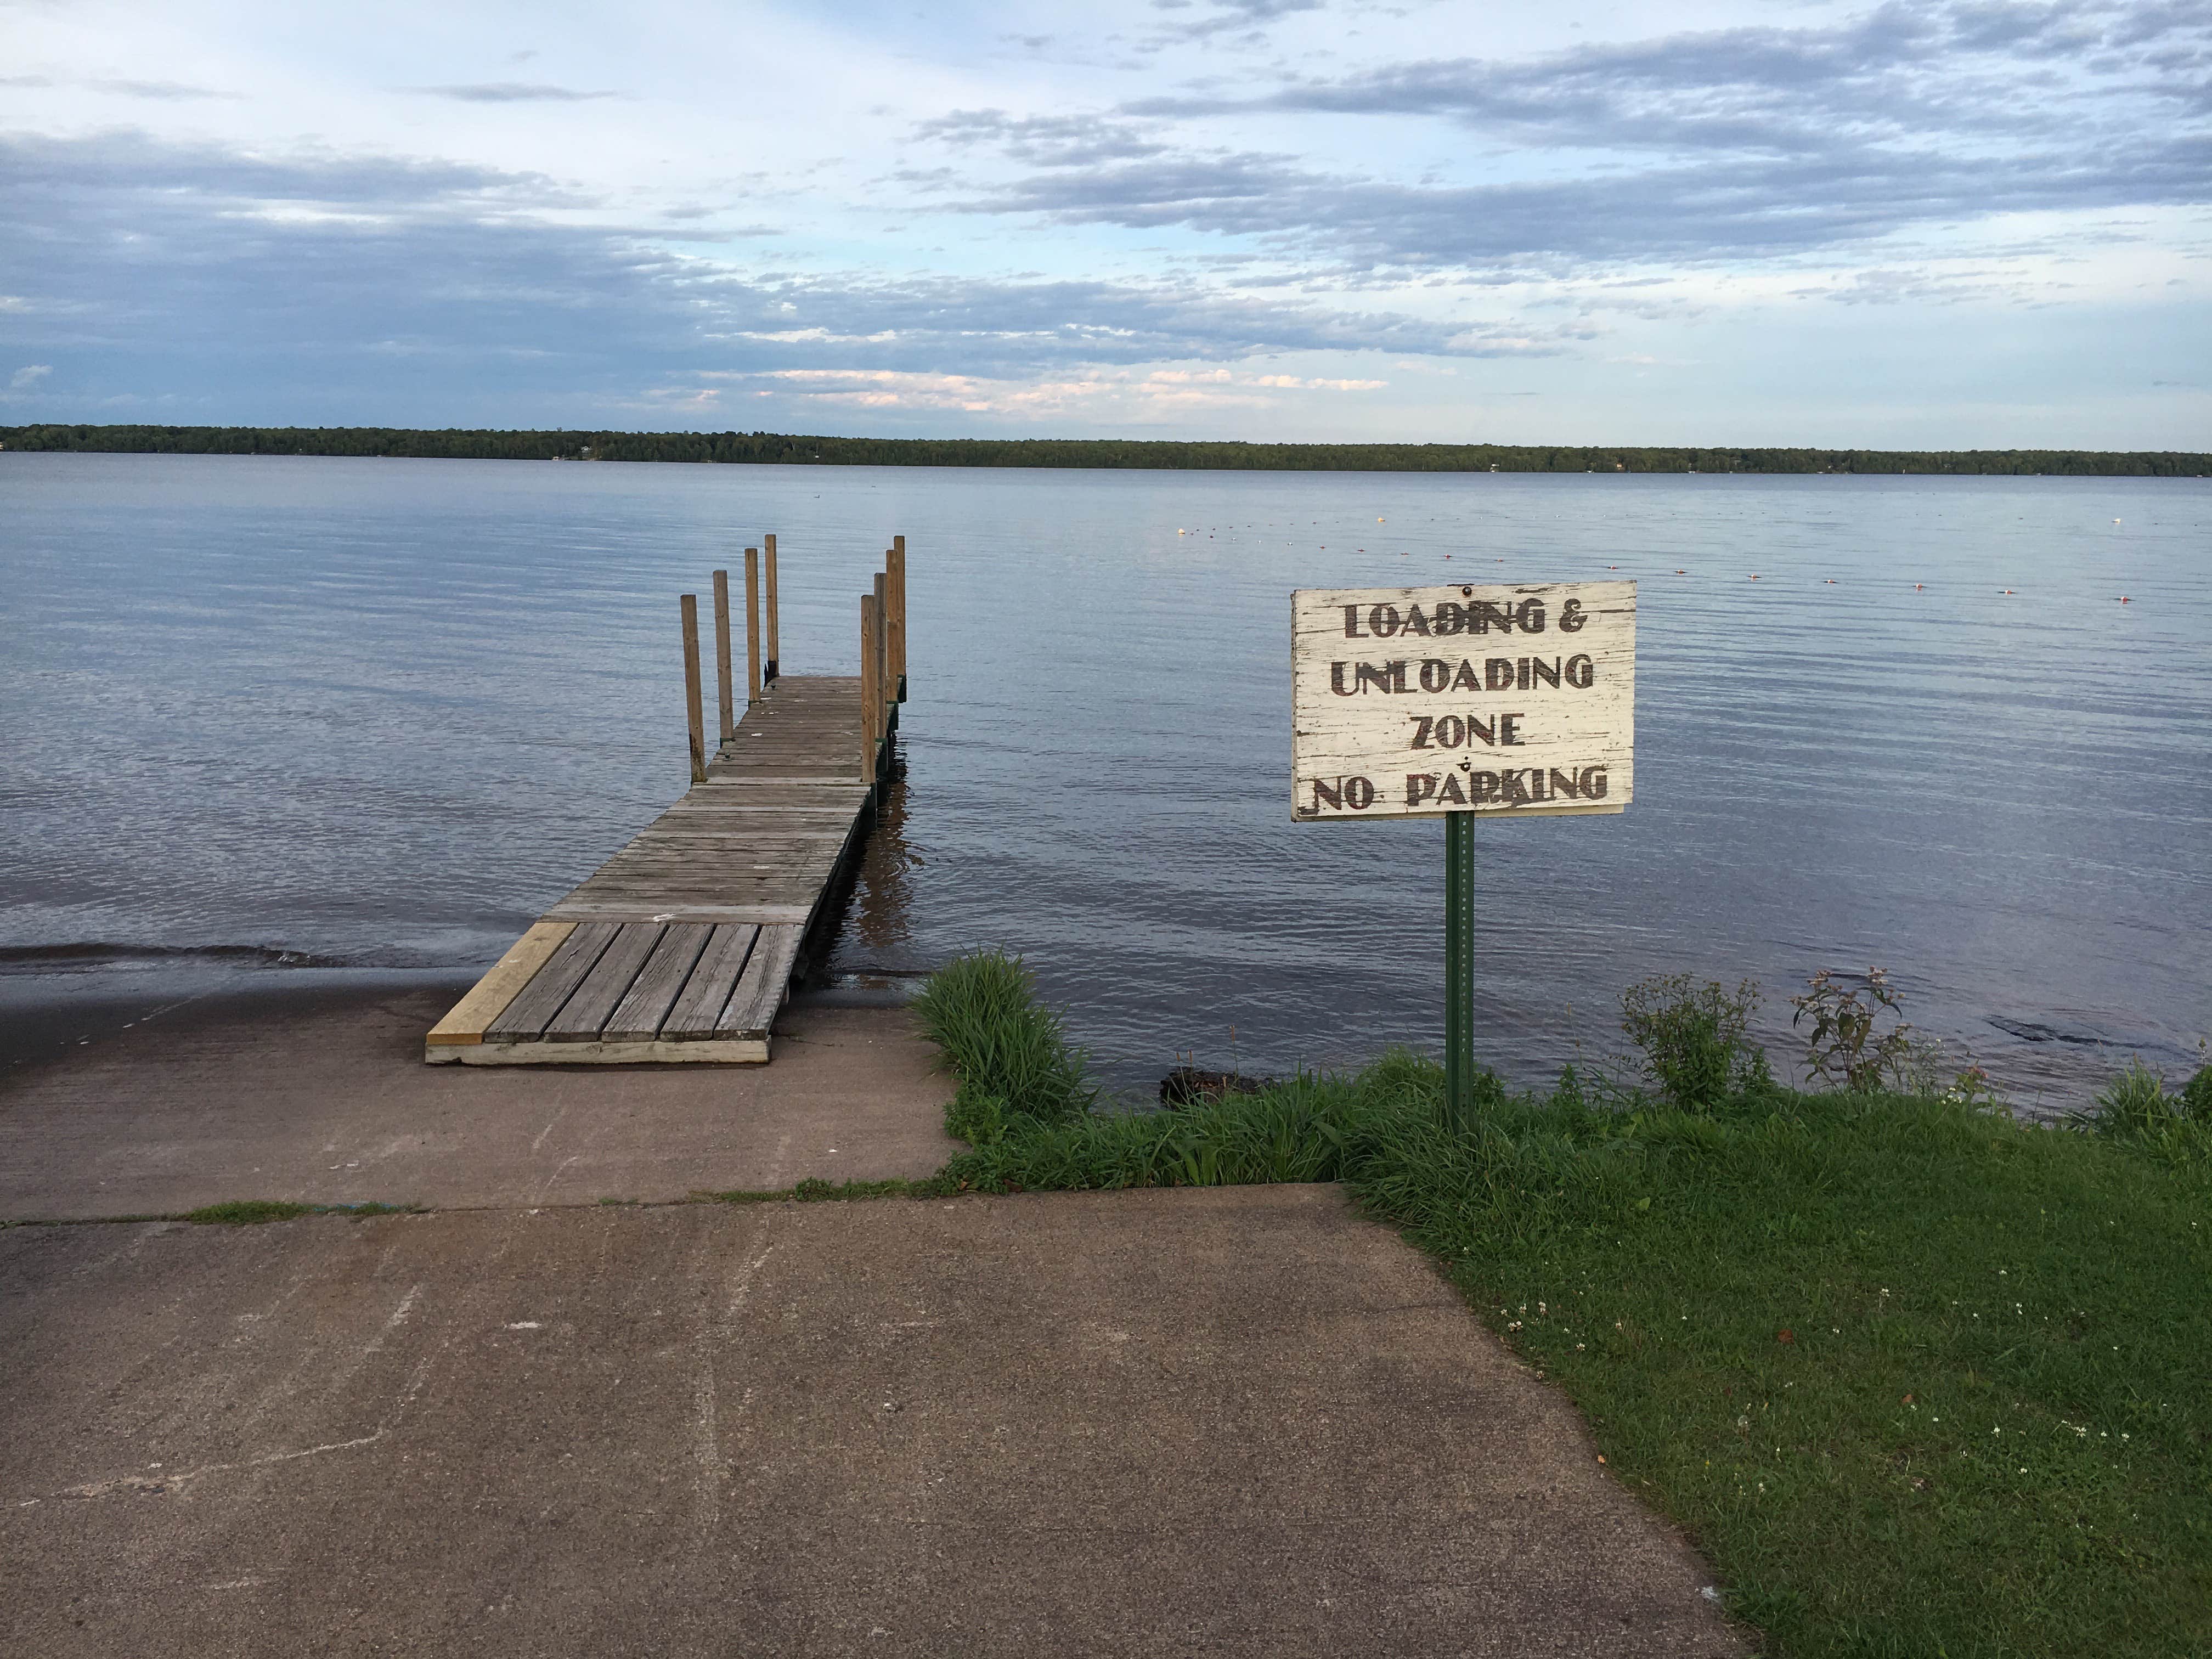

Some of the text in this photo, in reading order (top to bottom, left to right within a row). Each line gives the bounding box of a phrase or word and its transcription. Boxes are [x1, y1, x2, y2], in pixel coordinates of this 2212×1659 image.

[1345, 598, 1588, 638] LOADING &
[1331, 654, 1593, 696] UNLOADING
[1410, 713, 1525, 749] ZONE
[1314, 766, 1607, 810] NO PARKING
